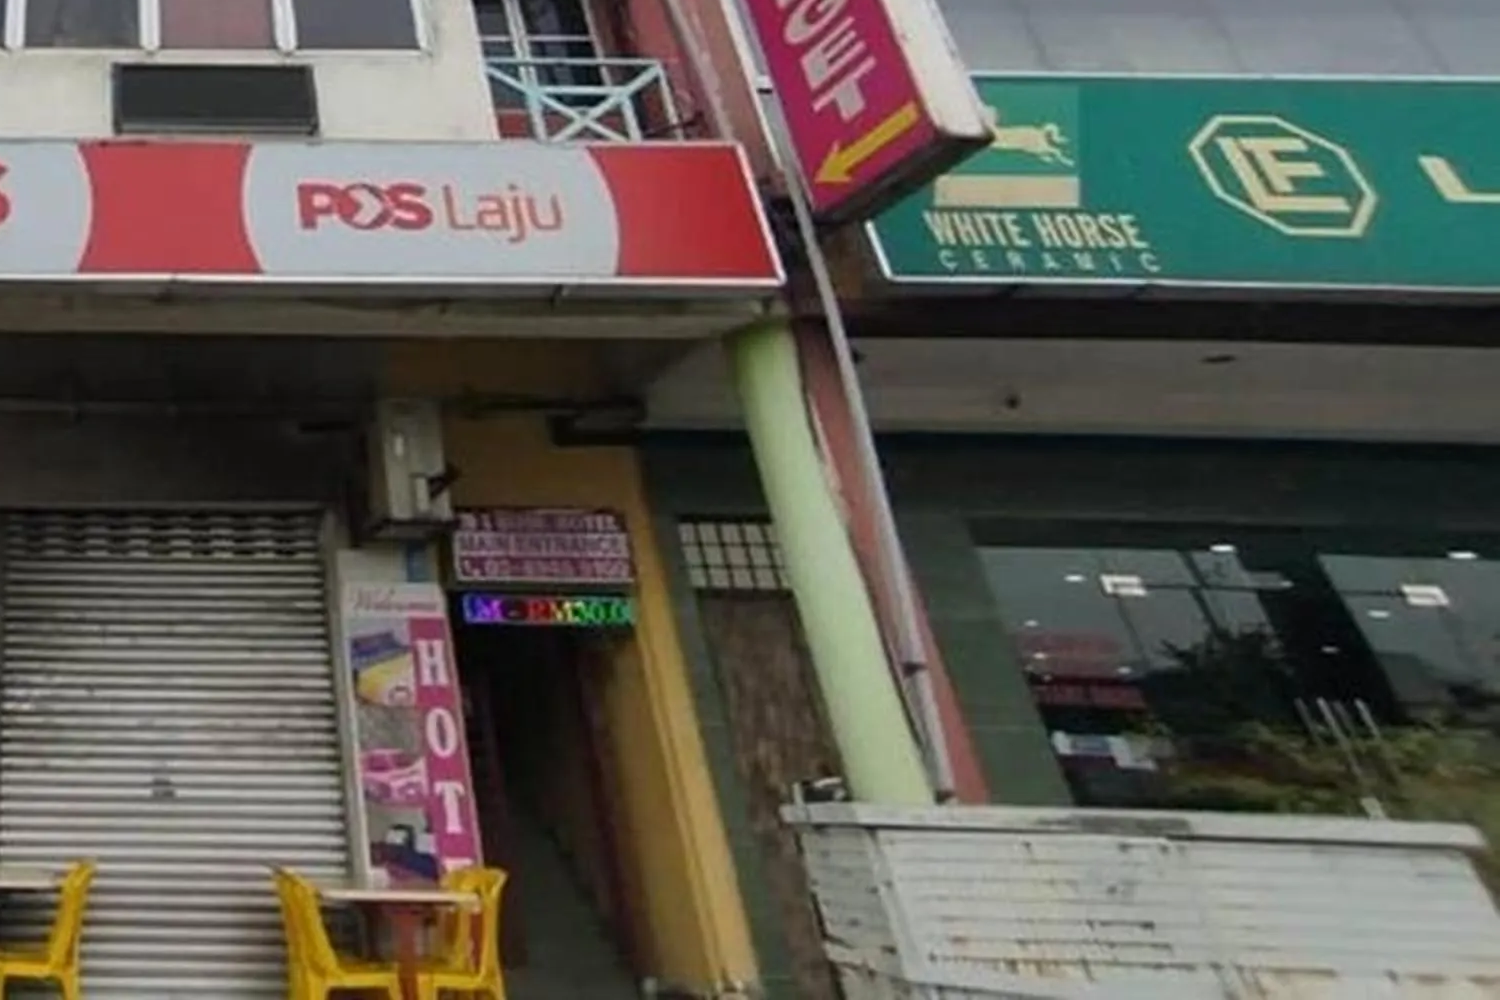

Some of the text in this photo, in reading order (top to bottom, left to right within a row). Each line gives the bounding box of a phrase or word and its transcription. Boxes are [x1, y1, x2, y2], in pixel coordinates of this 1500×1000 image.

[297, 183, 563, 243] POS Laju
[923, 211, 1150, 249] WHITE HORSE
[939, 250, 1162, 273] CERAMIC
